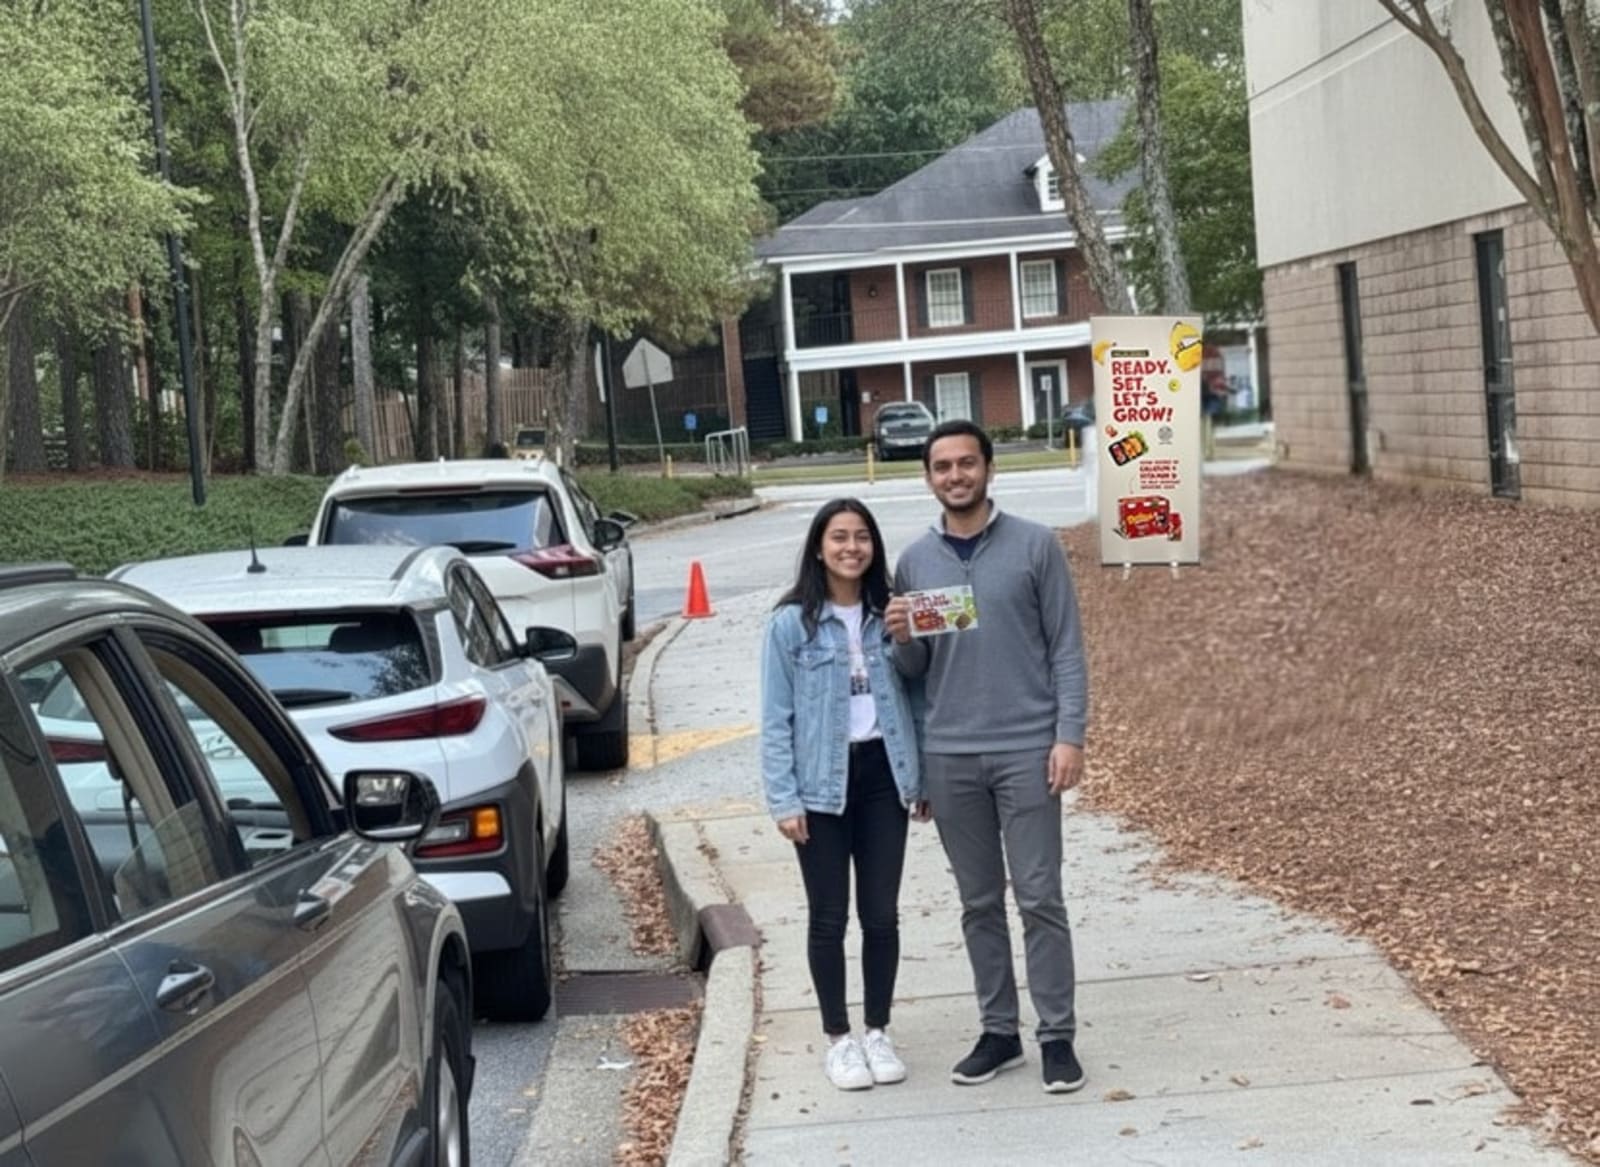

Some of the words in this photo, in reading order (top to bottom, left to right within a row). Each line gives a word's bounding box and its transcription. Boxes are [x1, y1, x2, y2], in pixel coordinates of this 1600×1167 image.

[1112, 361, 1171, 375] READY.
[1113, 377, 1147, 391] SET.
[1113, 392, 1158, 406] LET'S
[1113, 407, 1173, 422] GROW!
